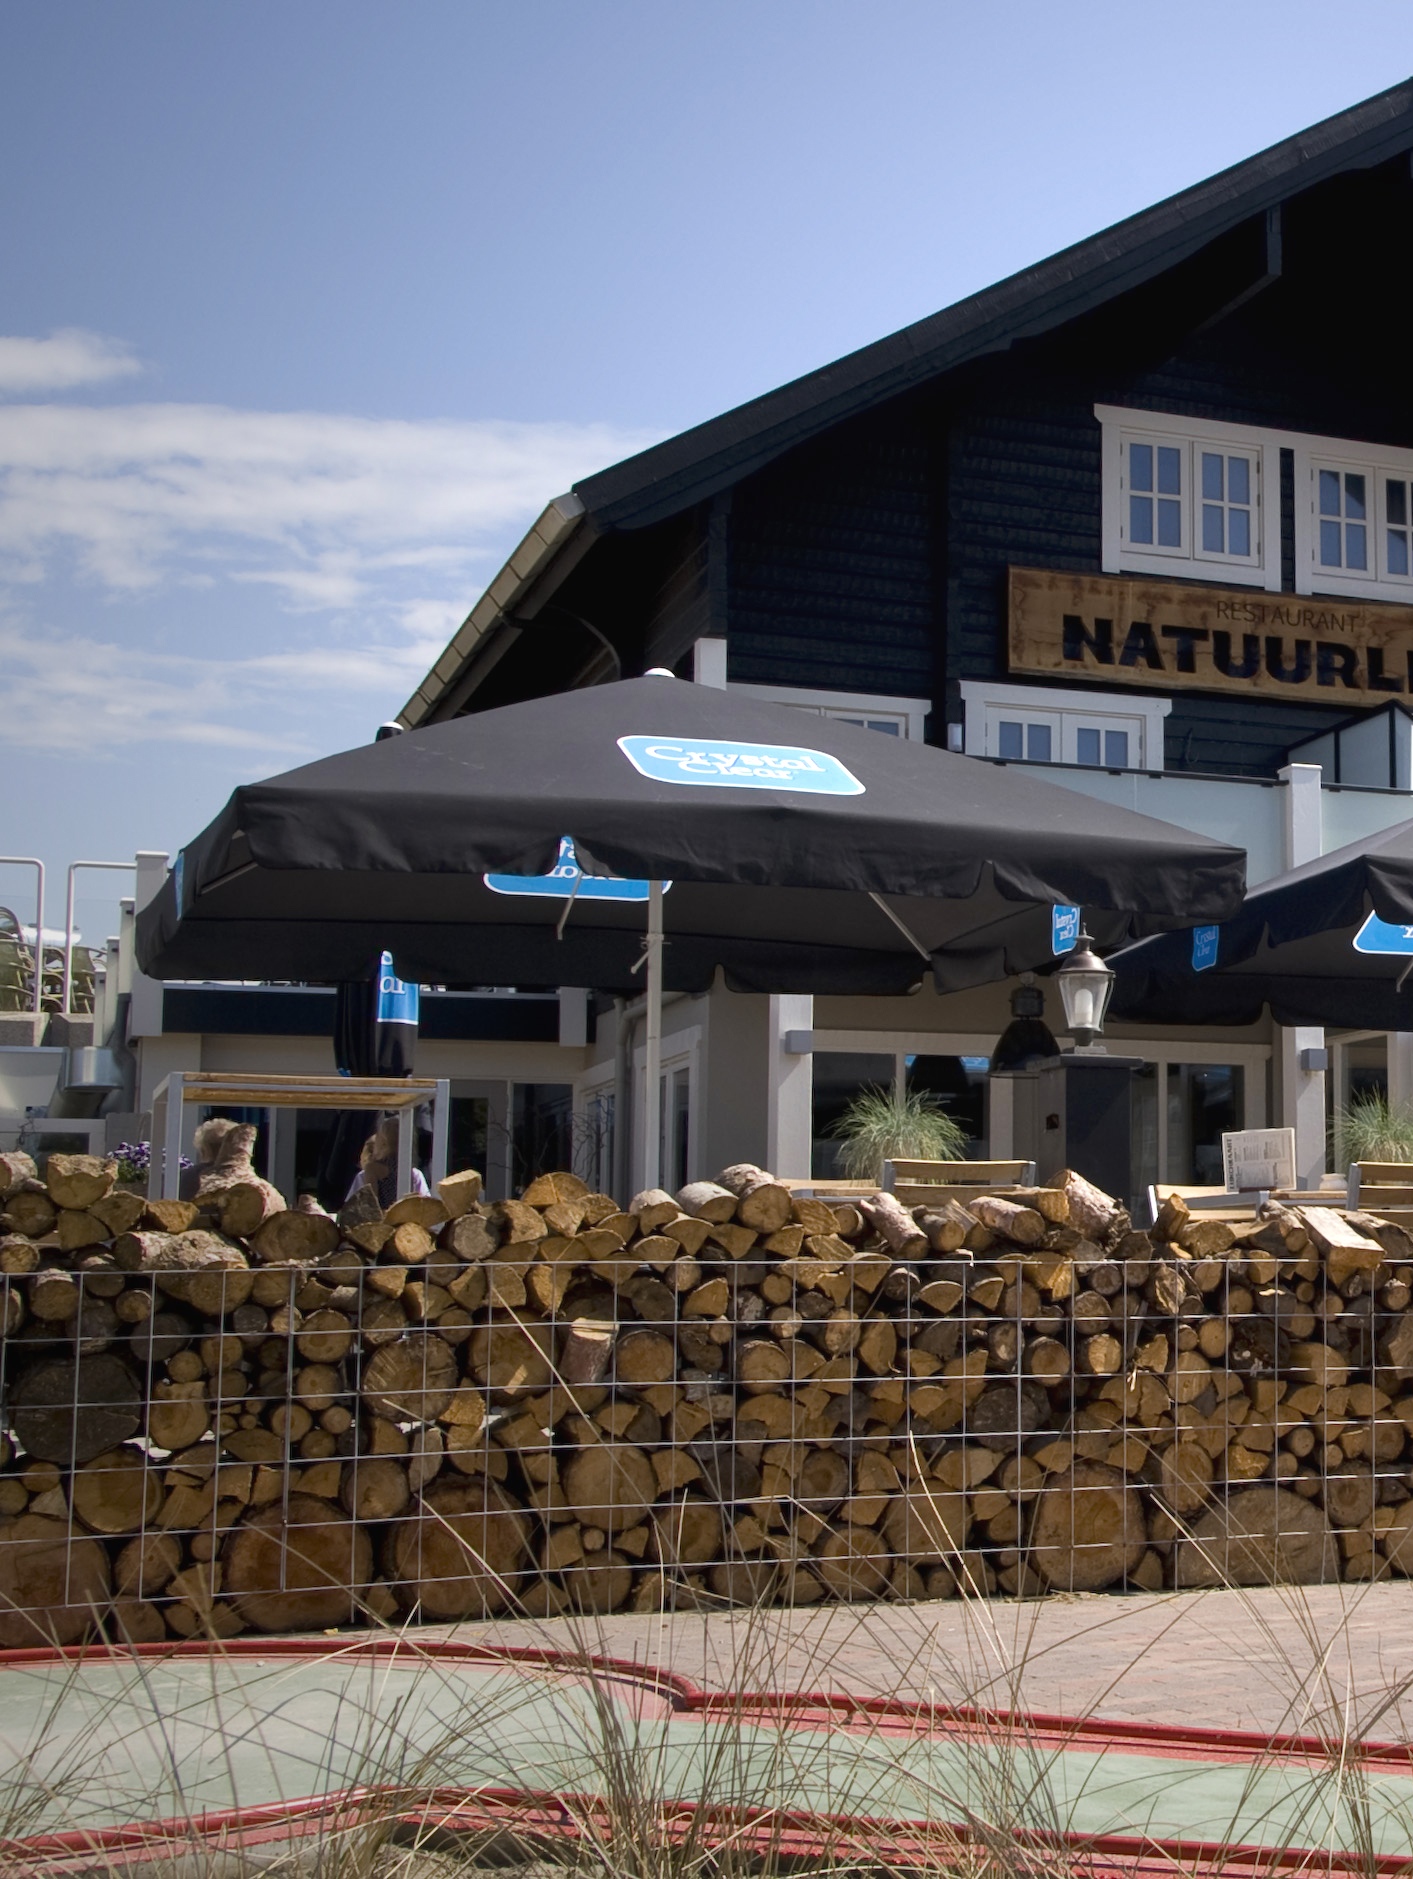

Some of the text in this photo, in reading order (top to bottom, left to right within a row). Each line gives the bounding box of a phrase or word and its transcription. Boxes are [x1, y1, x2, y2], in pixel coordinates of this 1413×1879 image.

[1215, 600, 1359, 634] RESTAURANT
[645, 745, 827, 772] Crystal
[678, 759, 794, 780] Clear
